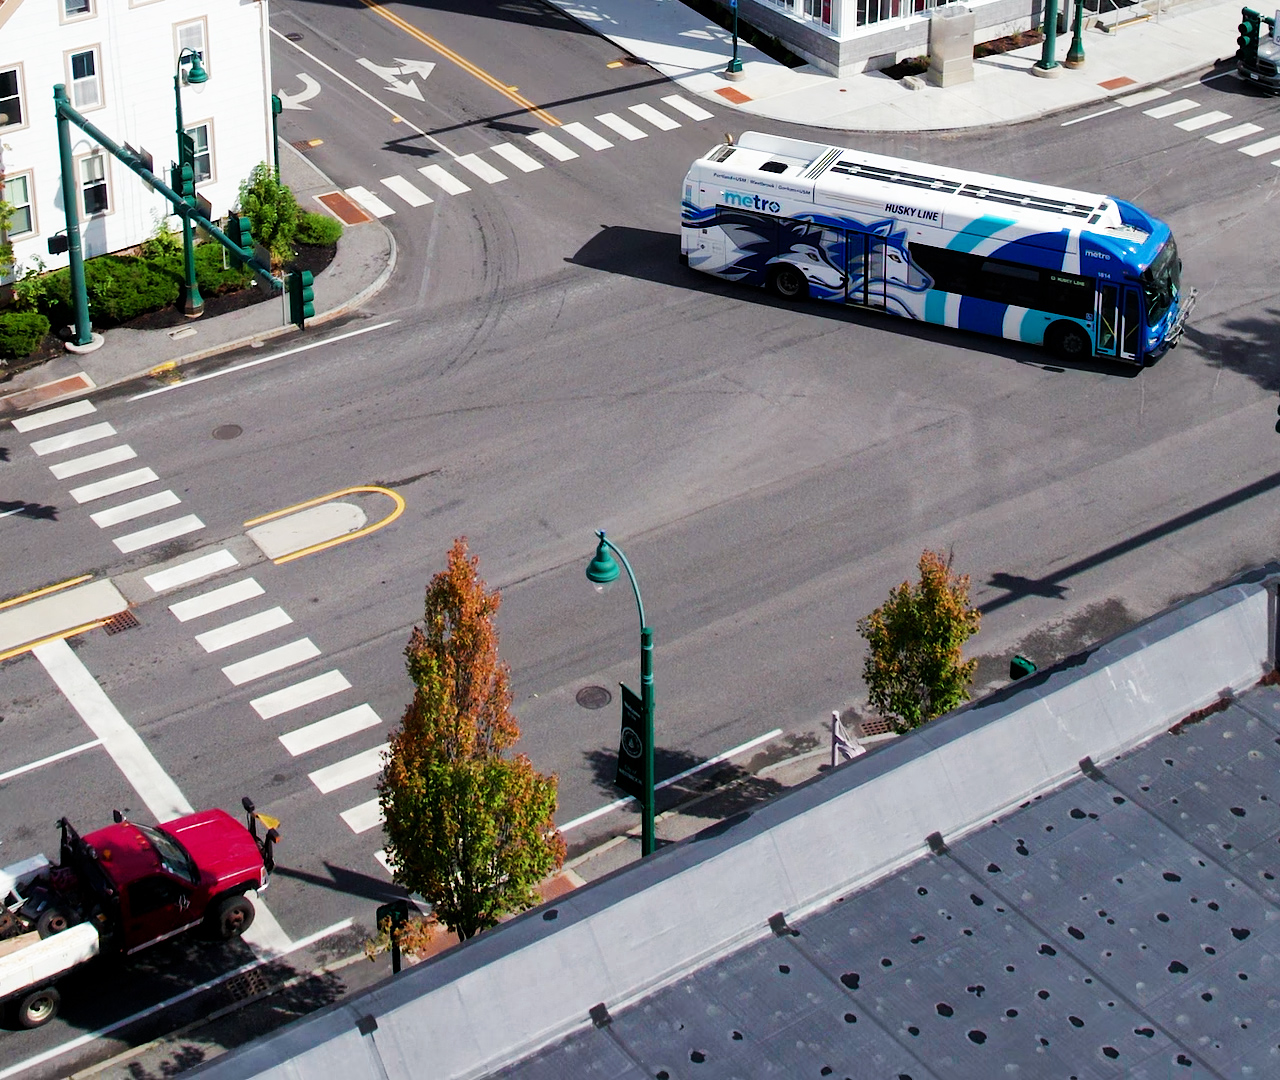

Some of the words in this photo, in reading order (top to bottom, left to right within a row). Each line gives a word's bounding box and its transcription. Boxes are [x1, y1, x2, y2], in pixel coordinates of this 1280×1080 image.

[724, 190, 781, 214] metro
[885, 203, 916, 217] HUSKY
[917, 209, 939, 222] LINE
[1084, 249, 1111, 261] metro
